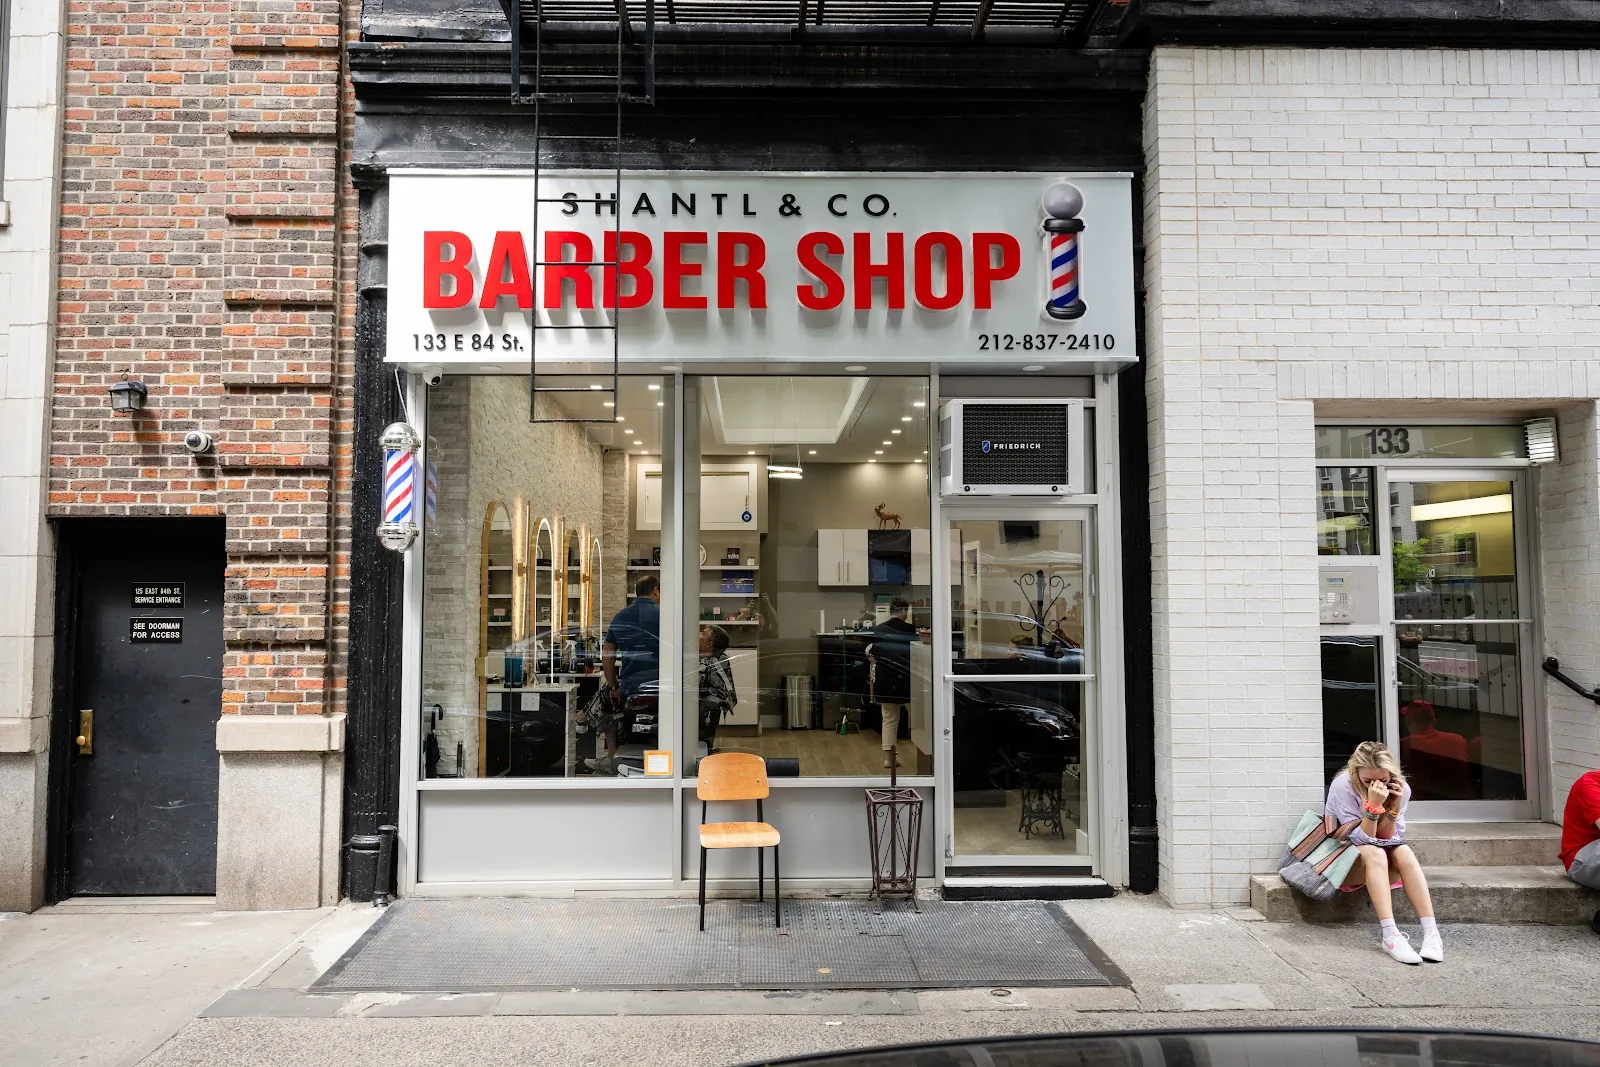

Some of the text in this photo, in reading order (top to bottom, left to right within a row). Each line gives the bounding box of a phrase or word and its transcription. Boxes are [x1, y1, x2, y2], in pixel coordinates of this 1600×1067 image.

[561, 192, 897, 217] SHANTL & CO.
[423, 230, 1021, 311] BARBER SHOP
[413, 333, 524, 351] 133 E 84 St.
[978, 333, 1115, 351] 212-837-2410
[1366, 428, 1410, 454] 133
[132, 631, 180, 639] FOR ACCESS
